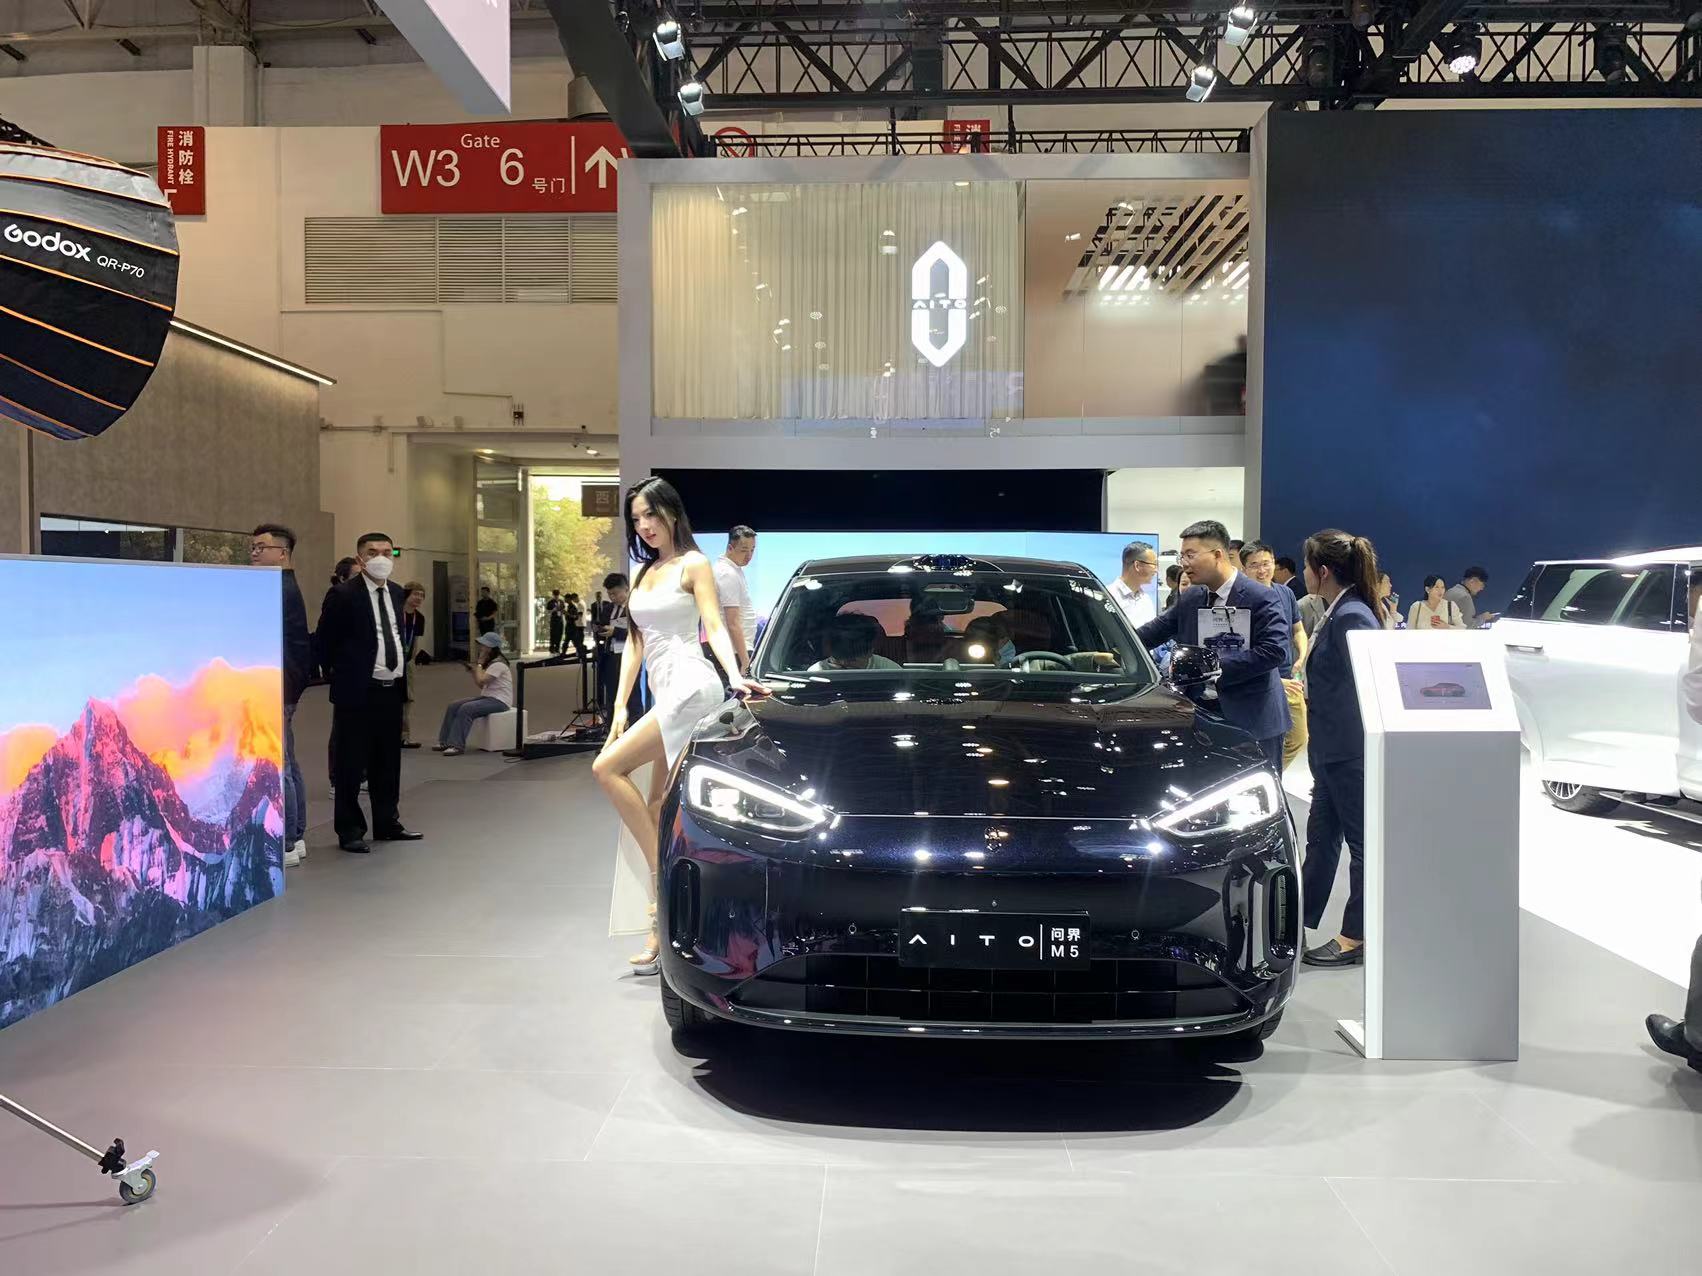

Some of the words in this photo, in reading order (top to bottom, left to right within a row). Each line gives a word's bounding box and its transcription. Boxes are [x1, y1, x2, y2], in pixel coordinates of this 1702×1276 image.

[460, 133, 501, 148] Gate
[167, 149, 175, 185] HYDRANT
[178, 130, 194, 185] 消防栓
[391, 150, 461, 187] W3
[4, 223, 91, 262] Godox
[97, 255, 145, 279] QR-P70
[912, 299, 967, 309] AITO
[908, 934, 1035, 948] AITO
[1051, 927, 1081, 942] 问界
